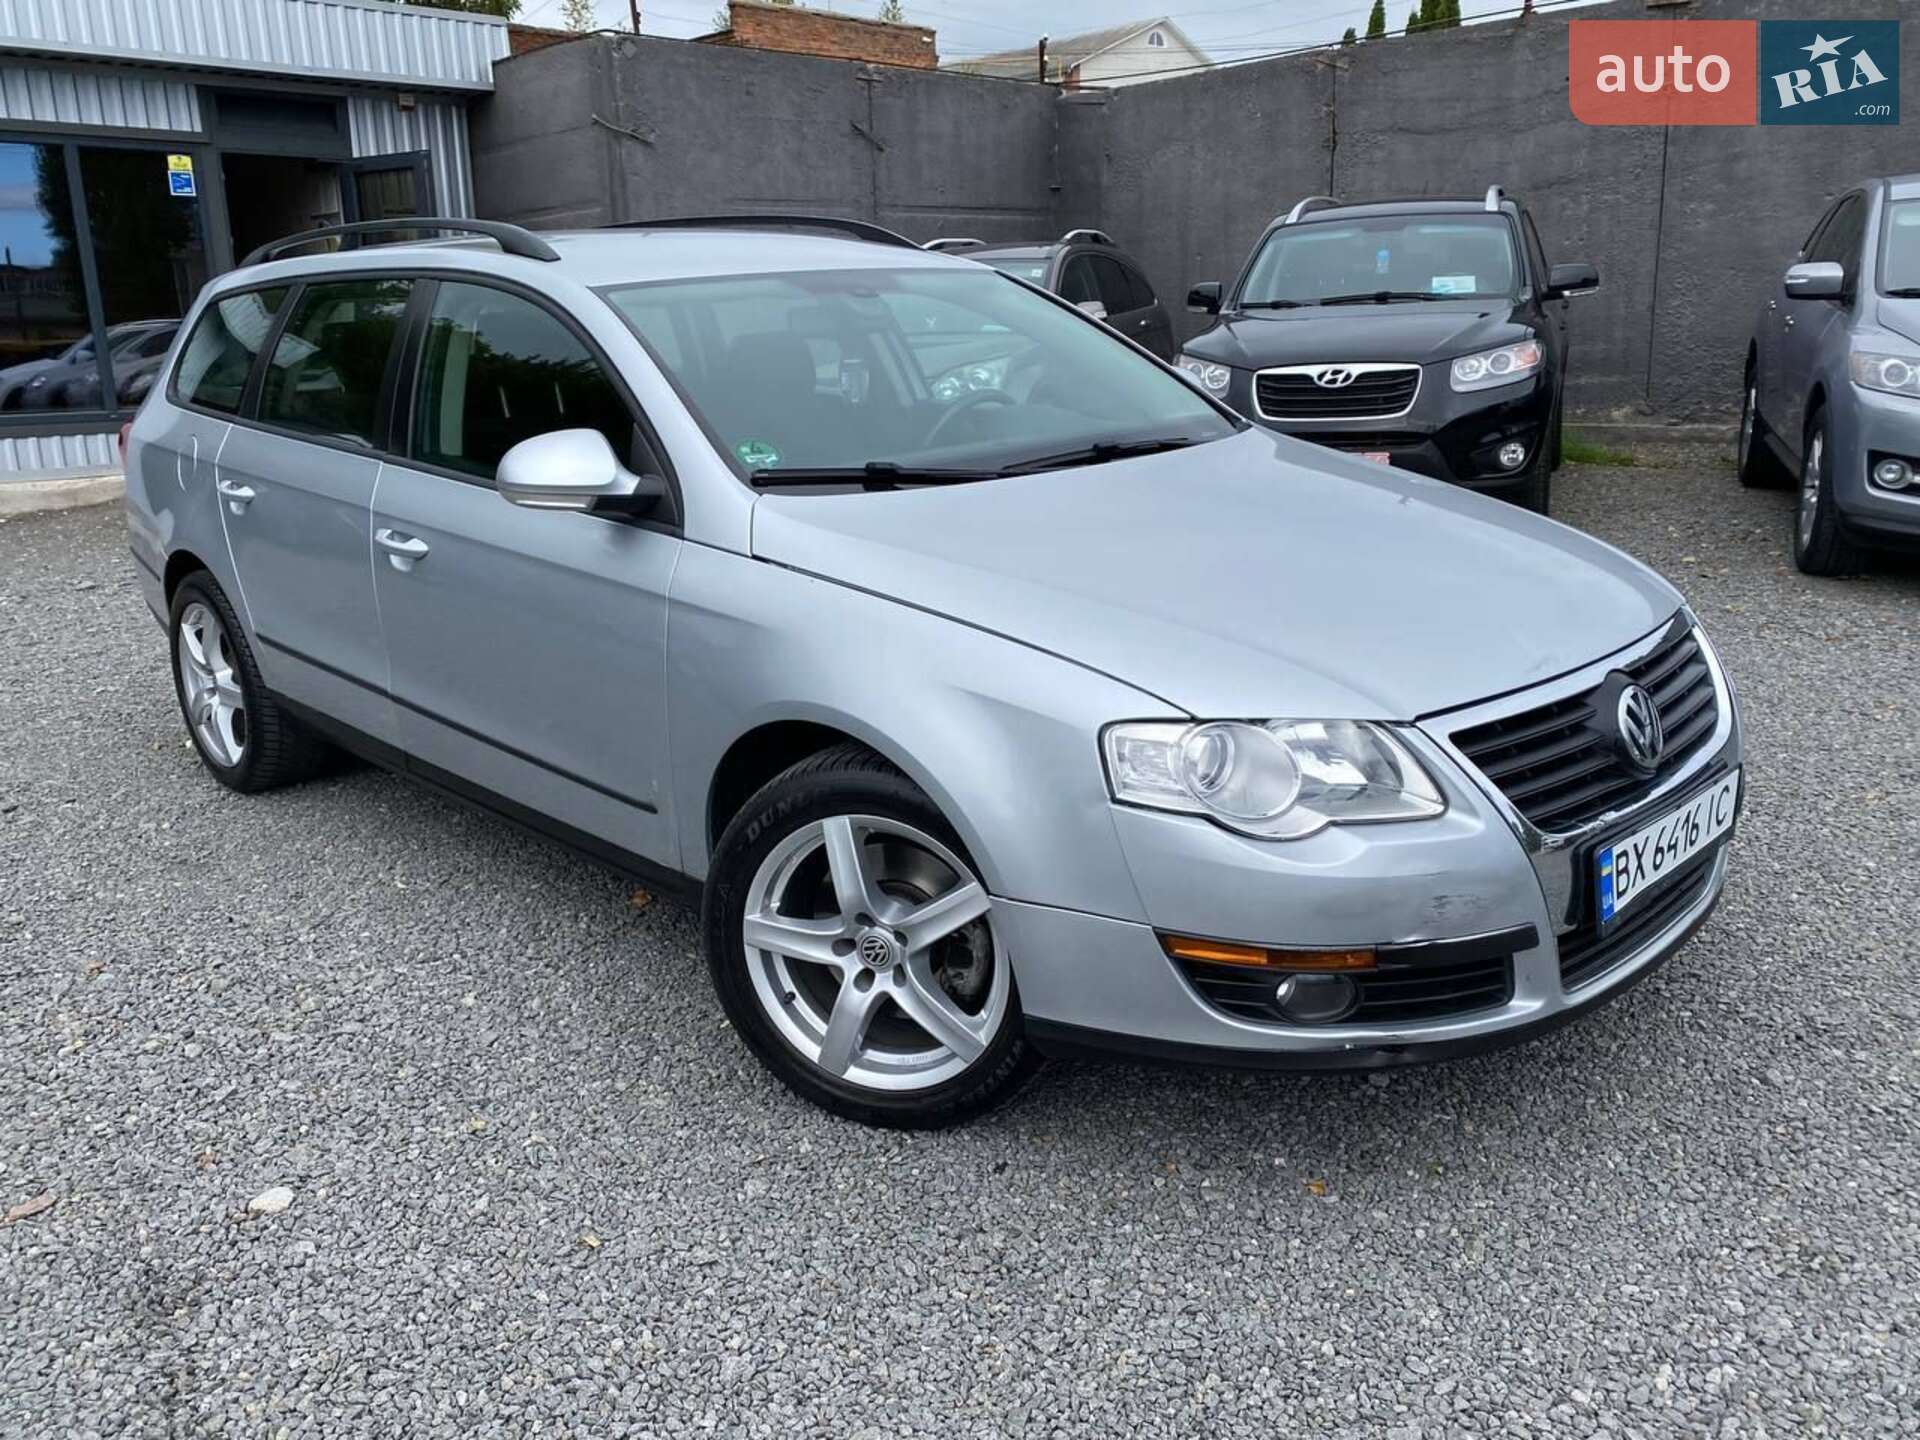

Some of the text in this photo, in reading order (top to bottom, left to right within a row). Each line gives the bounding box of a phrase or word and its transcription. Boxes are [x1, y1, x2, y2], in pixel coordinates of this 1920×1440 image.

[1615, 785, 1731, 900] BX 6416 IC
